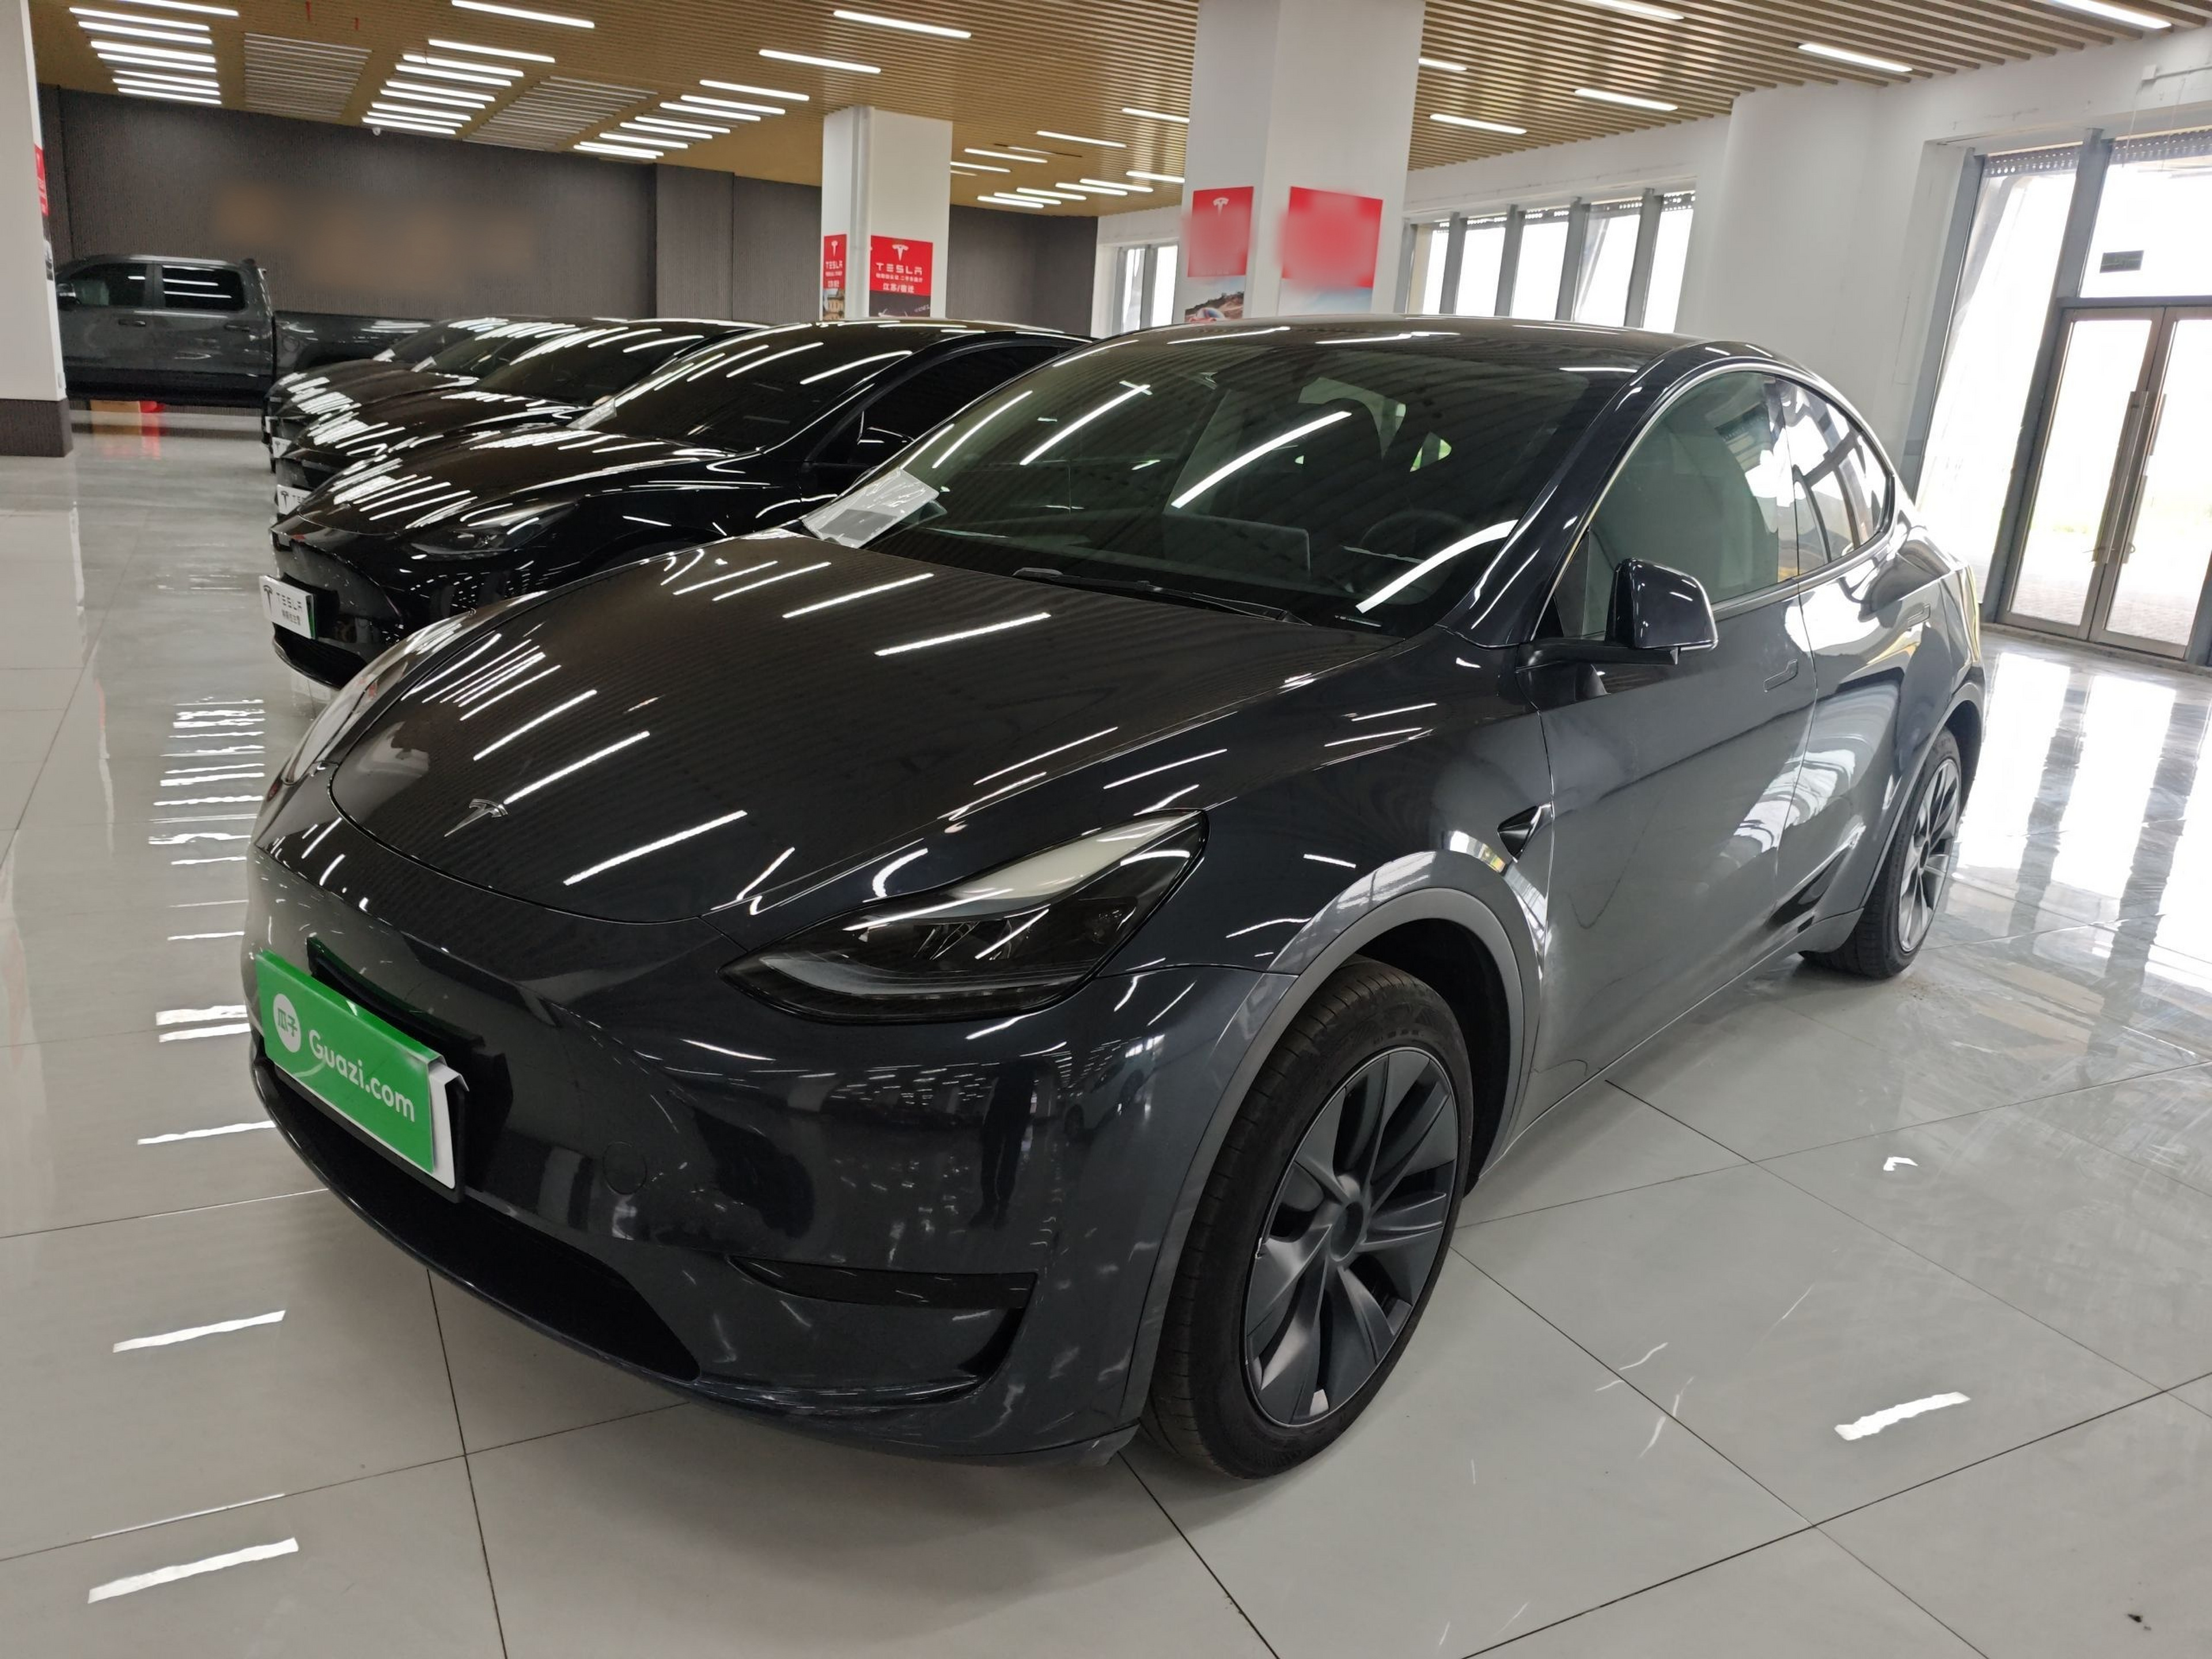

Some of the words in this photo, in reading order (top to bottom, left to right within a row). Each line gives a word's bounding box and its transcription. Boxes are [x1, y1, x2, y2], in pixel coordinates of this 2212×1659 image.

[825, 260, 843, 270] TESLA
[876, 262, 922, 275] TESLA
[277, 1007, 298, 1037] 瓜子
[308, 1029, 416, 1123] Guazi.com
